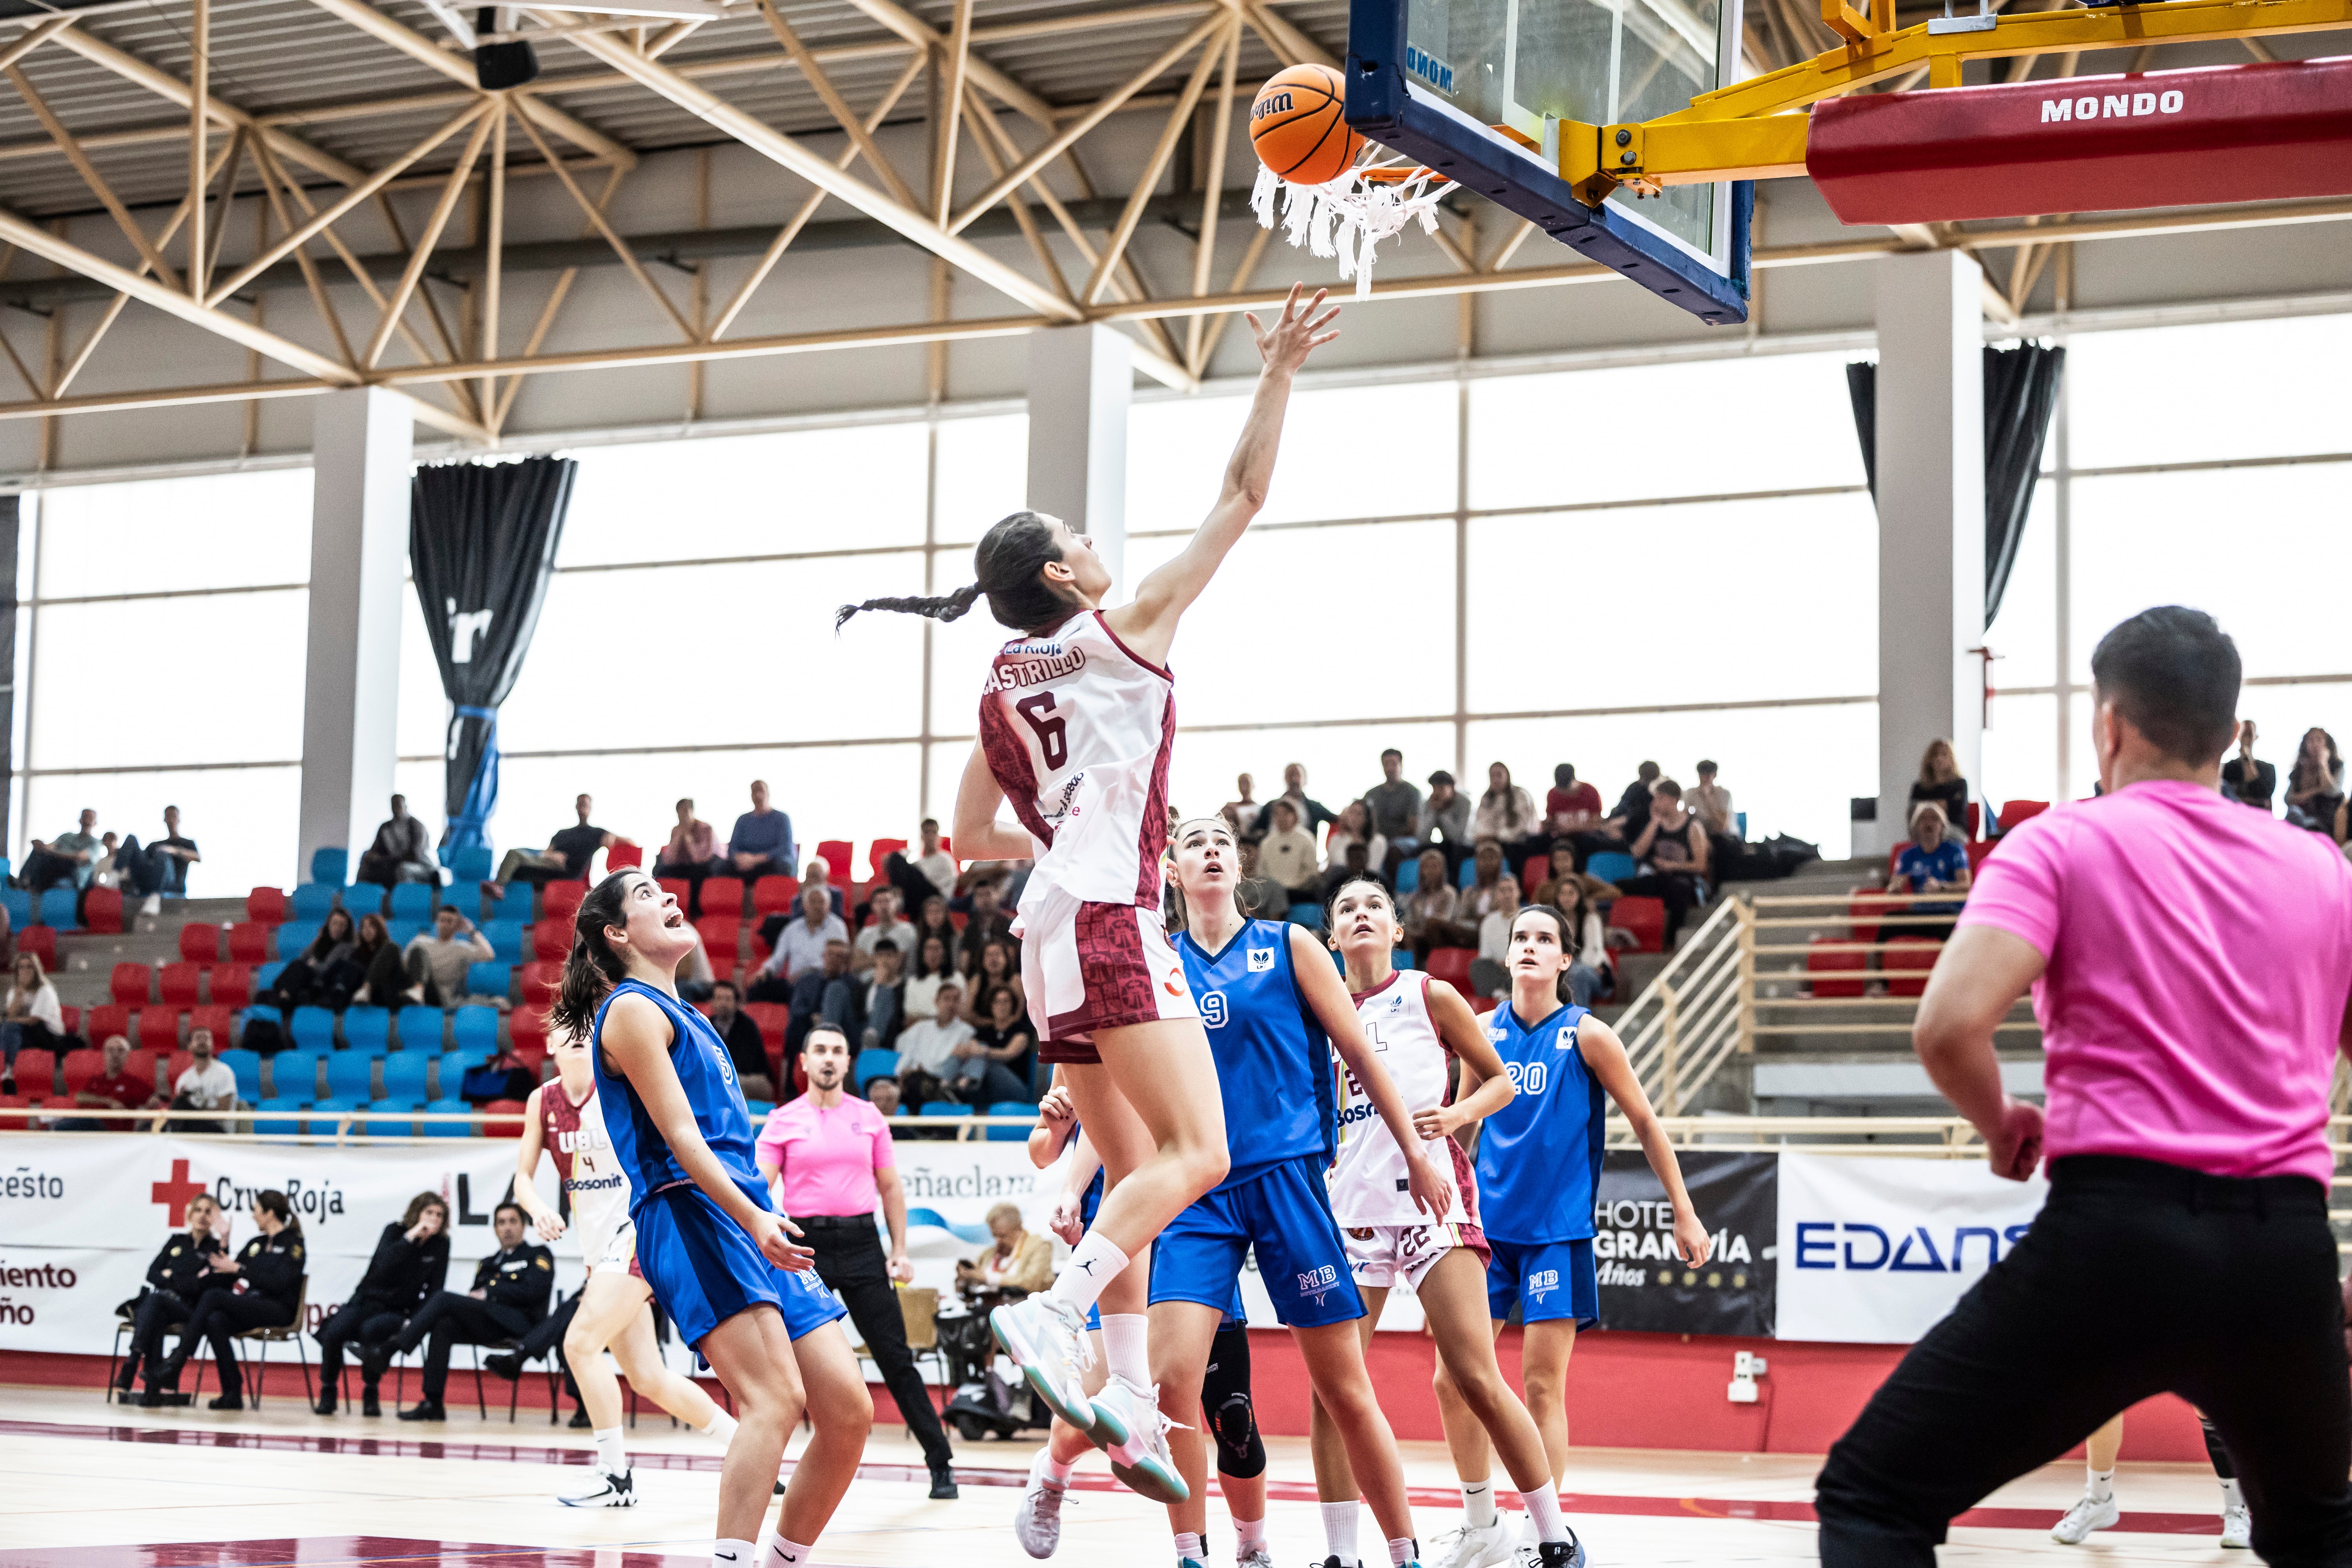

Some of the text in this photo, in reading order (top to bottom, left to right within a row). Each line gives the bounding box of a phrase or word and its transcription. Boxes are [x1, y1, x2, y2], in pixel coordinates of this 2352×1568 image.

[2041, 91, 2183, 123] MONDO
[1016, 691, 1067, 771] 6
[1200, 991, 1229, 1029] 9
[711, 1045, 733, 1085] 5
[1504, 1062, 1547, 1095] 20
[558, 1129, 608, 1153] UBL
[583, 1156, 595, 1172] 4
[564, 1174, 622, 1192] Bosonit
[217, 1176, 344, 1224] Cru Roja
[1595, 1200, 1673, 1229] HOTE
[1399, 1225, 1431, 1257] 22
[1297, 1265, 1336, 1290] MB
[1529, 1270, 1558, 1290] MB
